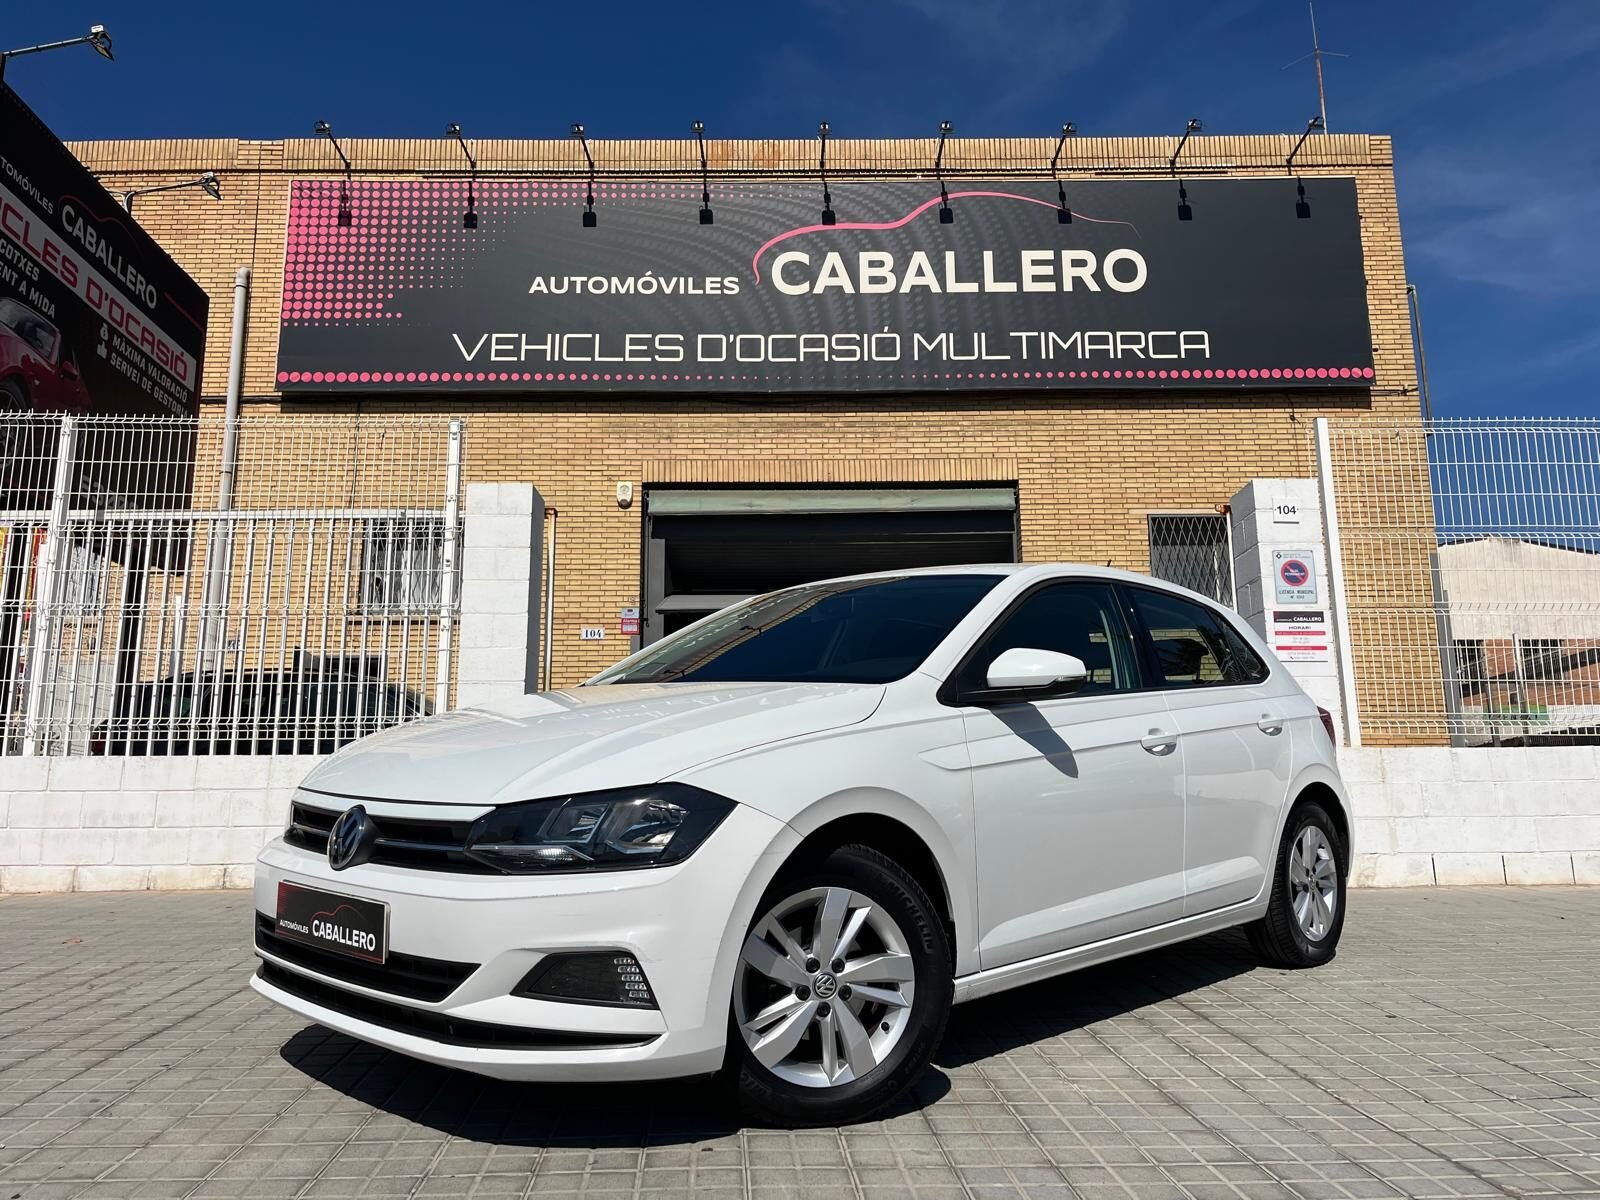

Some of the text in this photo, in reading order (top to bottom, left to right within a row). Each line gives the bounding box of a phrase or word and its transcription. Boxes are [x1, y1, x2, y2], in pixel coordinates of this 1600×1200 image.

[61, 204, 157, 309] CABALLERO
[528, 248, 1148, 296] AUTOMÓVILES CABALLERO
[18, 280, 27, 295] A
[29, 287, 55, 320] MIDA
[86, 276, 187, 381] D'OCASIÓ
[451, 326, 1210, 362] VEHICLES D'OCASIÓ MULTIMARCA
[110, 352, 141, 384] SERVEI
[141, 376, 152, 393] DE
[147, 361, 188, 403] VALORACIÓ
[1276, 505, 1297, 515] 104
[585, 630, 602, 638] 104
[279, 919, 376, 952] AUTOMÓVILES CABALLERO
